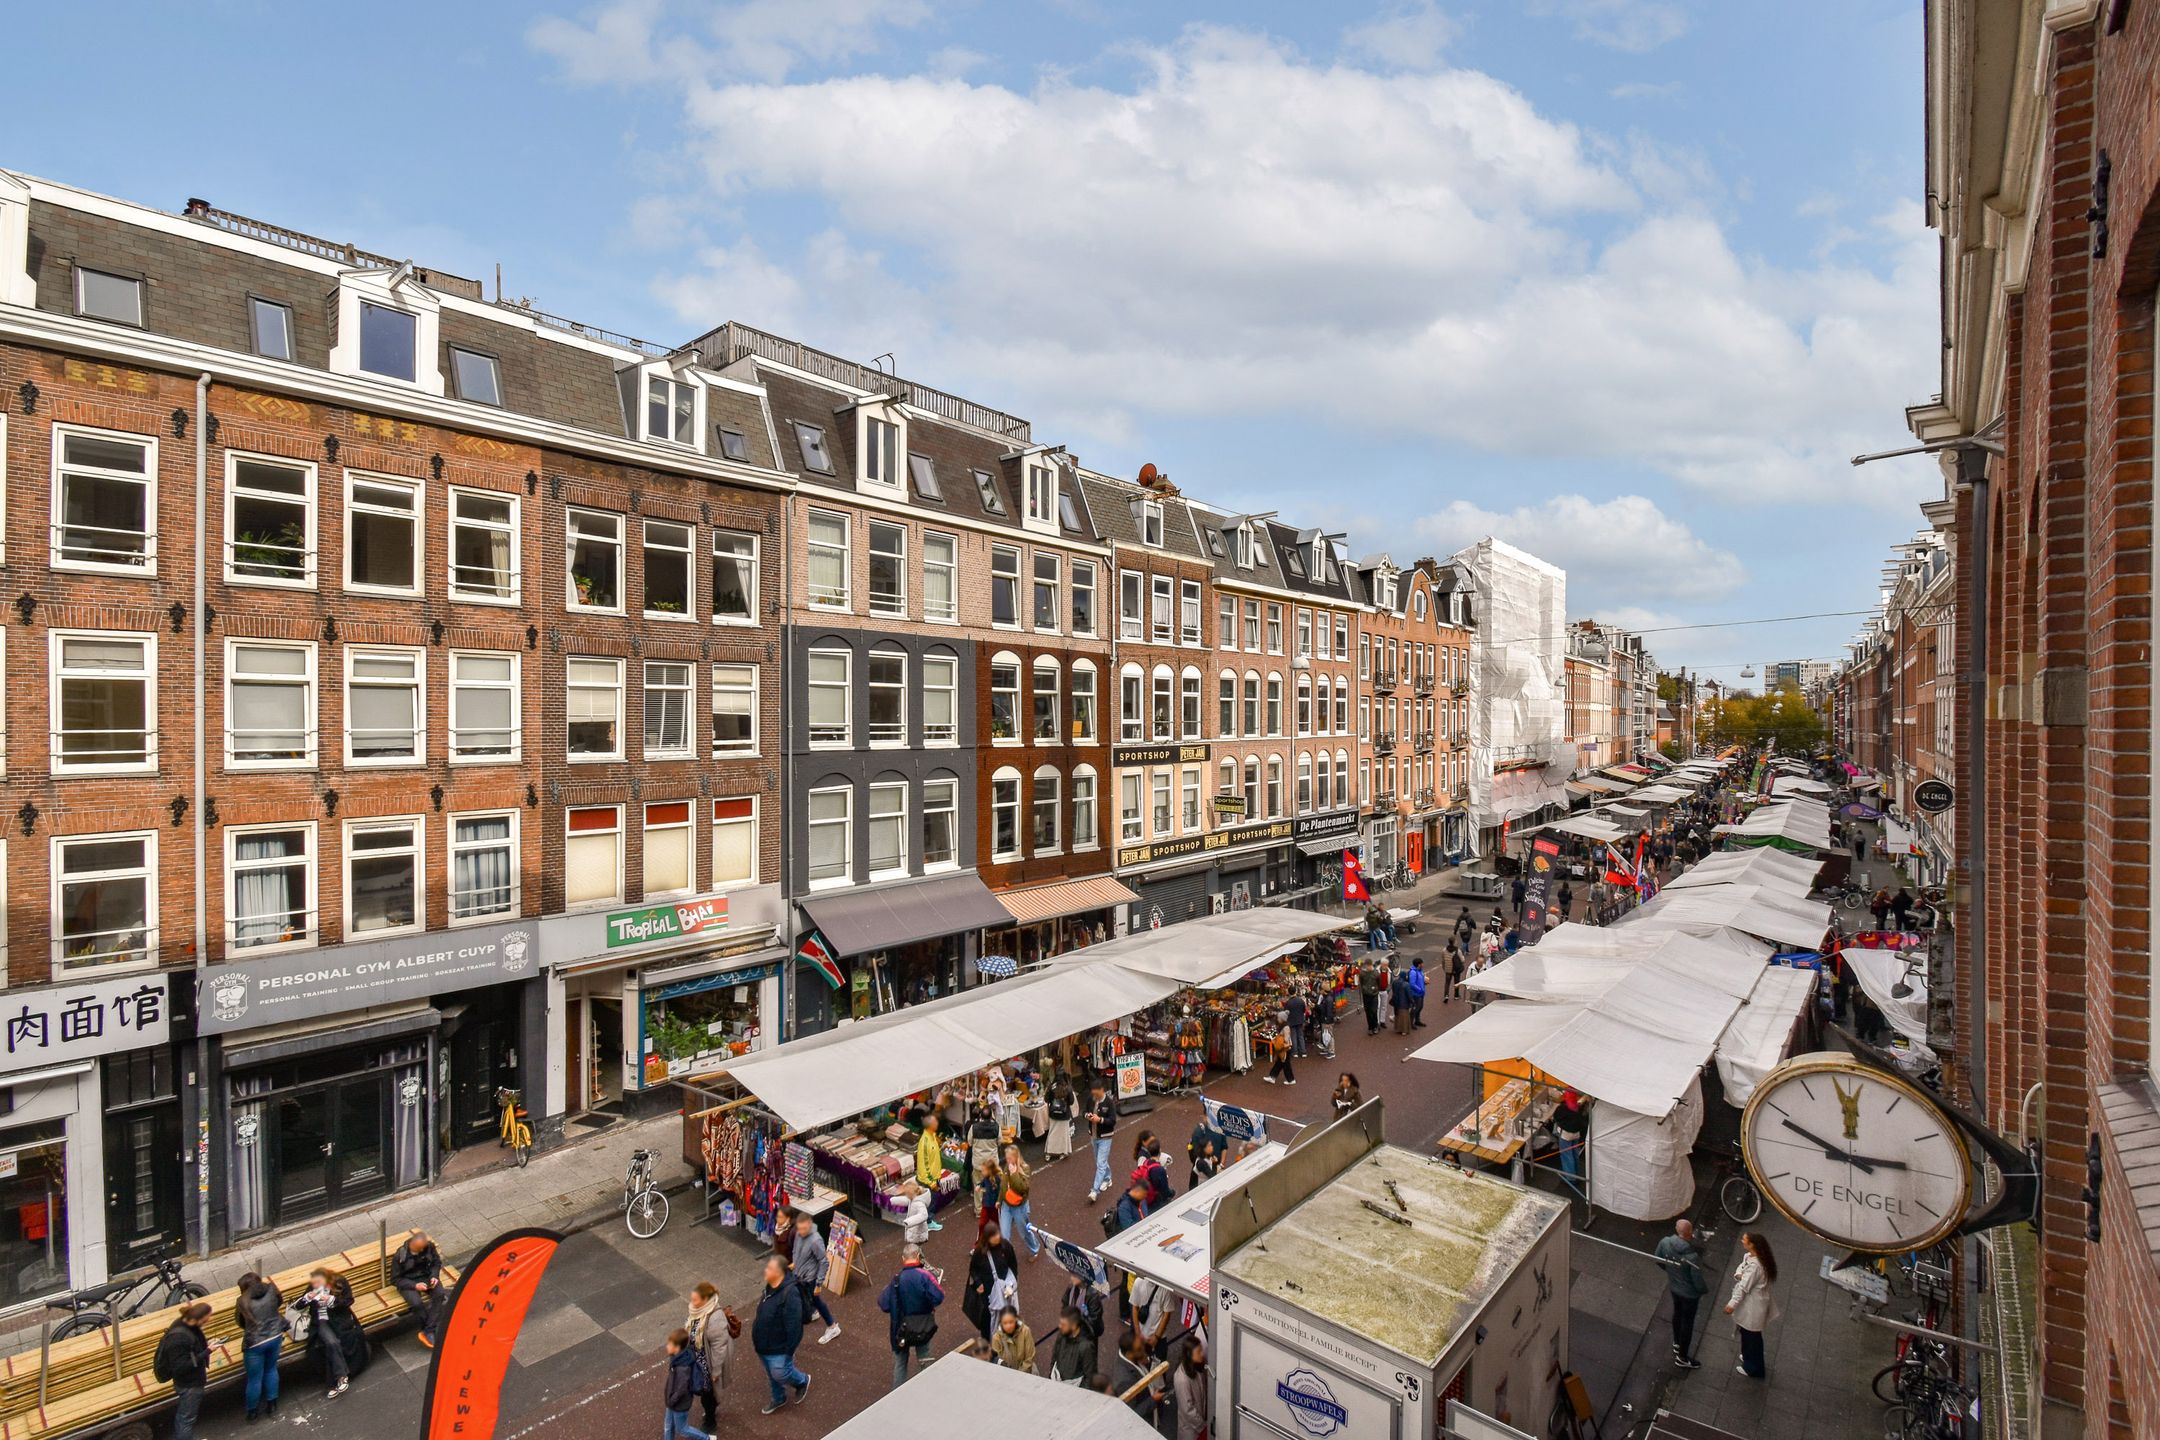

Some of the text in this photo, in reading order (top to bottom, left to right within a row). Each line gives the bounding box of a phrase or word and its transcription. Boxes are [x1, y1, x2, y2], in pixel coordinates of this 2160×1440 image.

[1120, 748, 1204, 761] SPORTSHOP PETER JAN
[1300, 822, 1310, 832] De
[1311, 814, 1355, 830] Plantenmarkt
[1122, 851, 1138, 864] PETER
[1139, 848, 1149, 860] JAN
[1154, 841, 1200, 856] SPORTSHOP
[1233, 829, 1271, 841] SPORTSHOP
[610, 916, 678, 940] TROPICAL
[260, 944, 496, 990] PERSONAL GYM ALBERT CUYP
[260, 994, 300, 1005] PERSONAL
[302, 988, 338, 998] TRAINING
[345, 983, 368, 991] SMALL
[370, 978, 394, 987] GROUP
[396, 973, 429, 982] TRAINING
[466, 961, 496, 971] TRAINING
[8, 984, 164, 1053] 肉面馆
[1220, 1112, 1250, 1127] RUDI'S
[1795, 1176, 1910, 1216] DE ENGEL
[472, 1252, 518, 1345] SHANTI
[1252, 1307, 1378, 1372] TRADITIONEEL FAMILIE RECEPT
[1280, 1387, 1344, 1420] STROOPWAFELS
